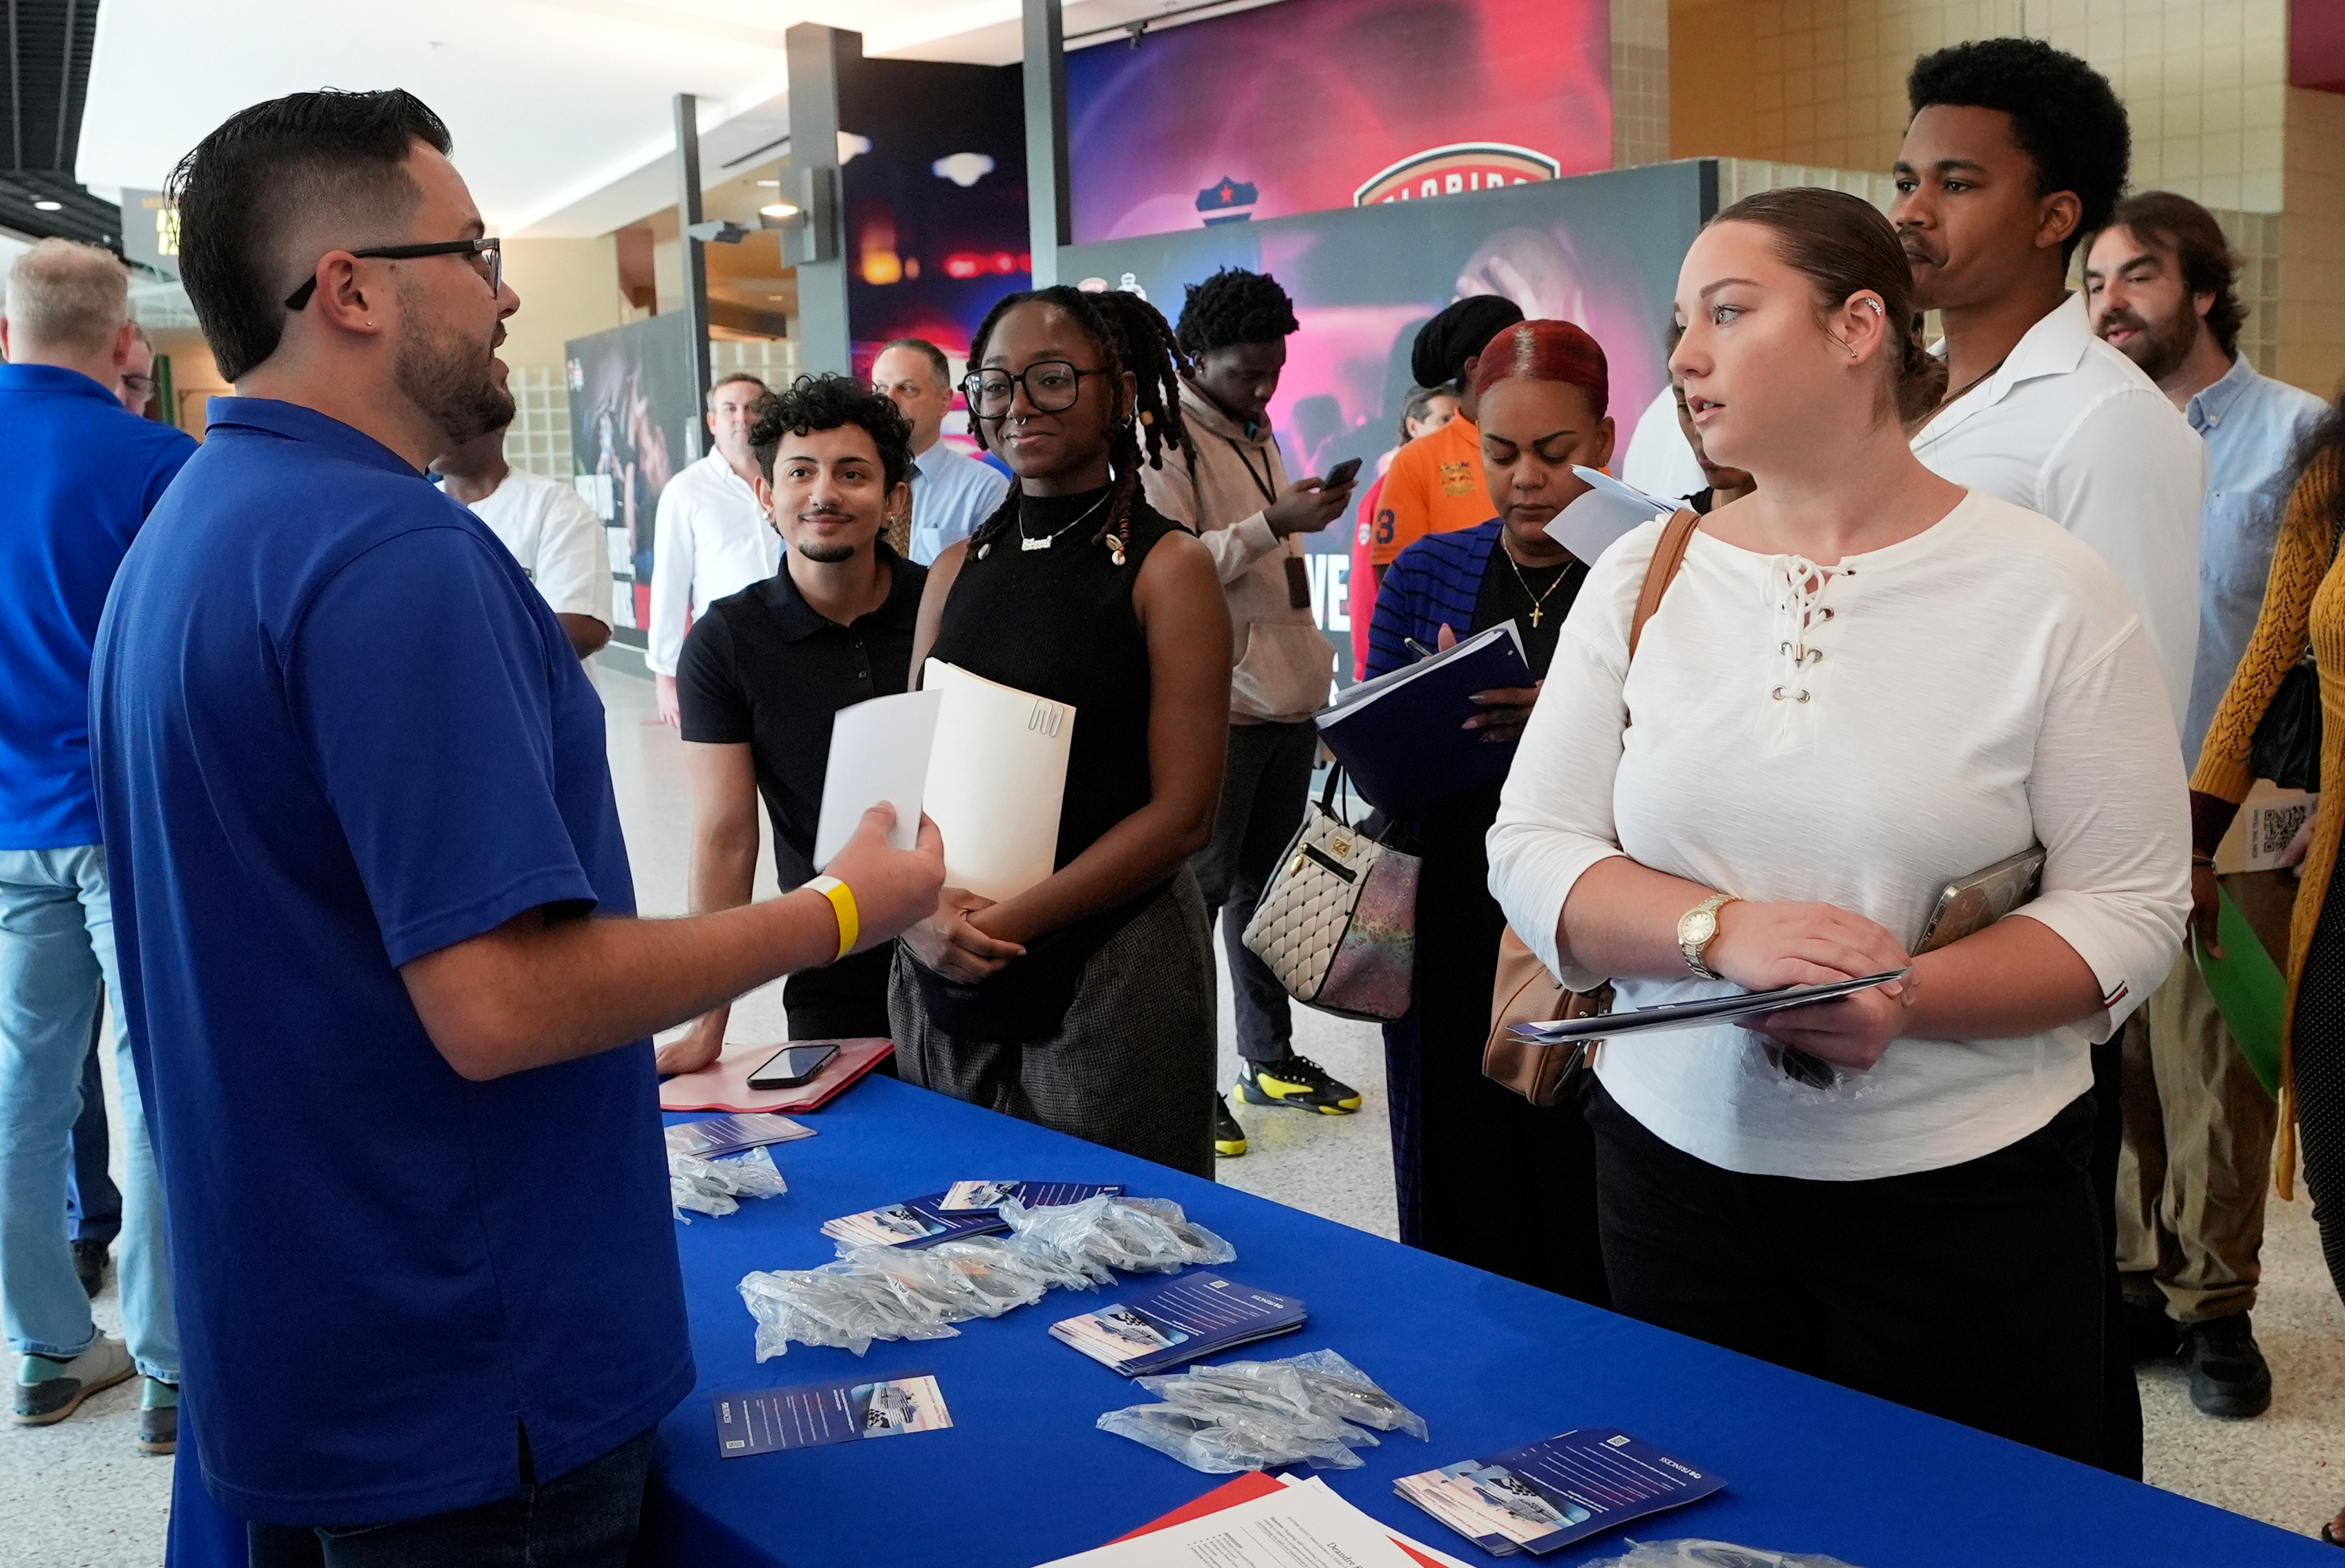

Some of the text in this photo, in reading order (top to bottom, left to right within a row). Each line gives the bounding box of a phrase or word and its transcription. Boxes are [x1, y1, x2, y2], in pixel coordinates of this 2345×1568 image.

[1382, 171, 1528, 204] ORID
[1376, 509, 1395, 544] 3
[1326, 1542, 1356, 1566] Deandre
